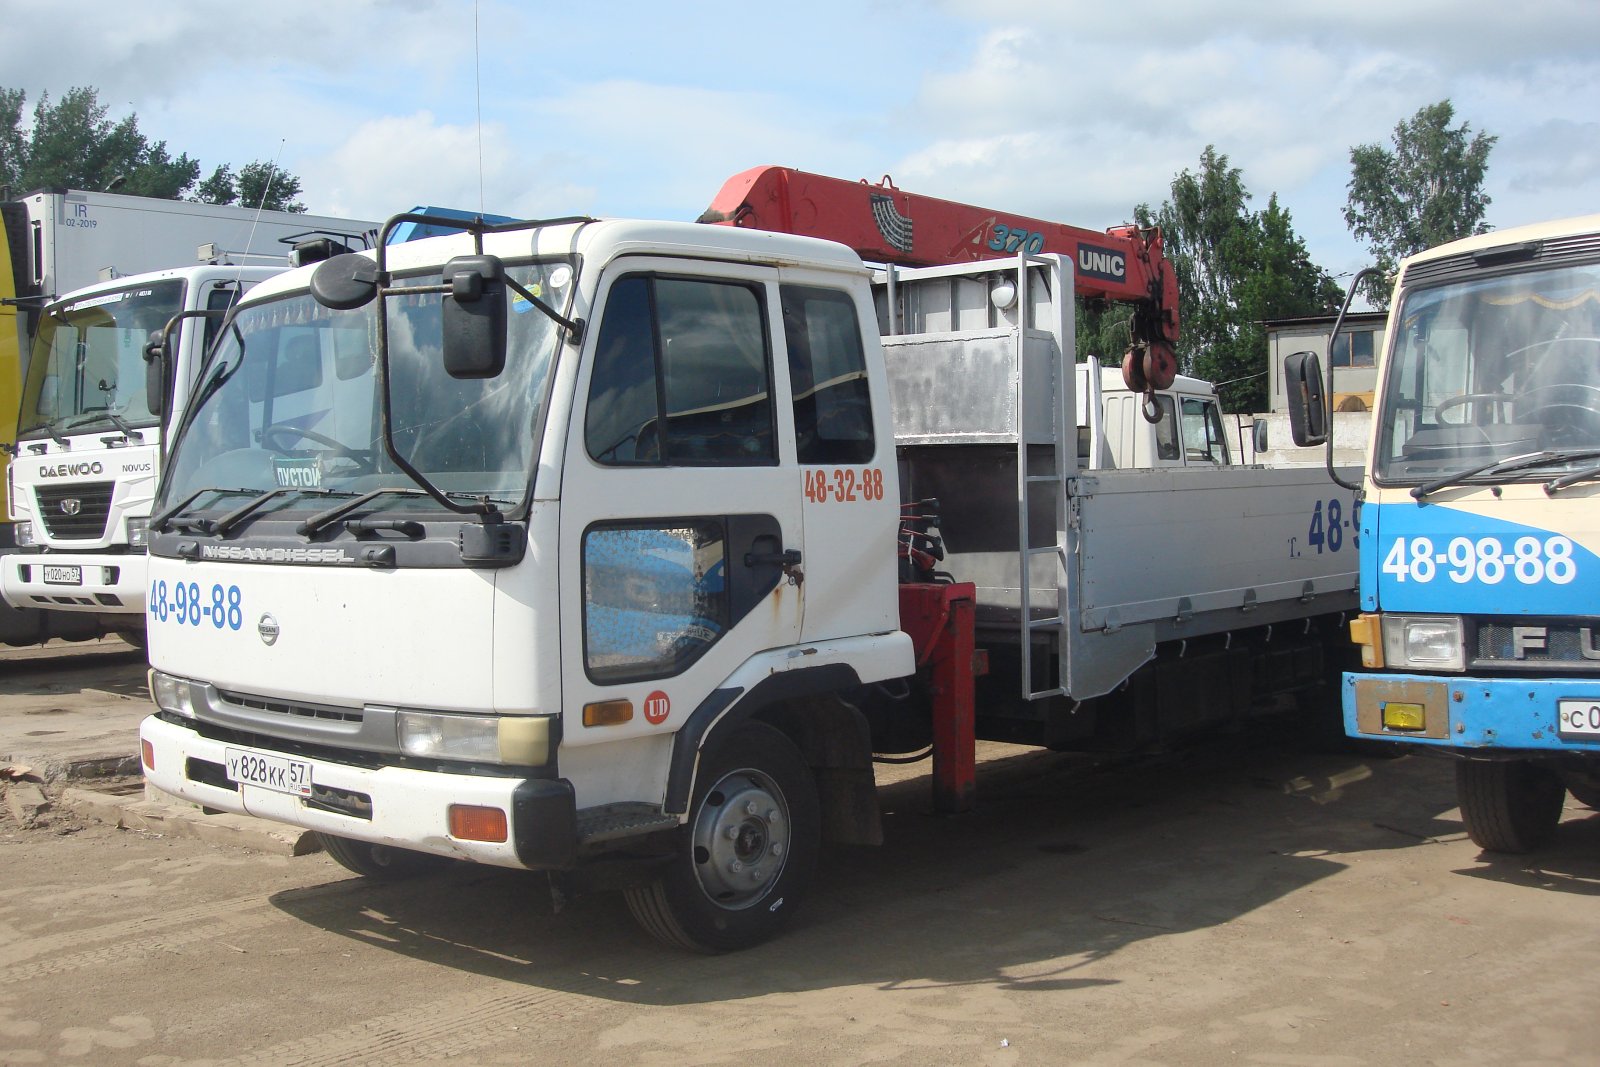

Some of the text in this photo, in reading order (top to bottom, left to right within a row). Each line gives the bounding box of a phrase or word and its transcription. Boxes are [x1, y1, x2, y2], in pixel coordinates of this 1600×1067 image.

[74, 204, 87, 217] IR
[988, 224, 1045, 255] 370
[1079, 248, 1125, 278] UNIC
[39, 461, 151, 478] DAEWOO NOVUS
[276, 462, 320, 487] ПУСТОЙ
[805, 468, 884, 503] 48-32-88
[203, 545, 355, 563] NISSAN DIESEL
[1382, 535, 1577, 585] 48-98-88
[150, 579, 243, 631] 48-98-88
[648, 698, 668, 717] UD
[290, 763, 304, 783] 57
